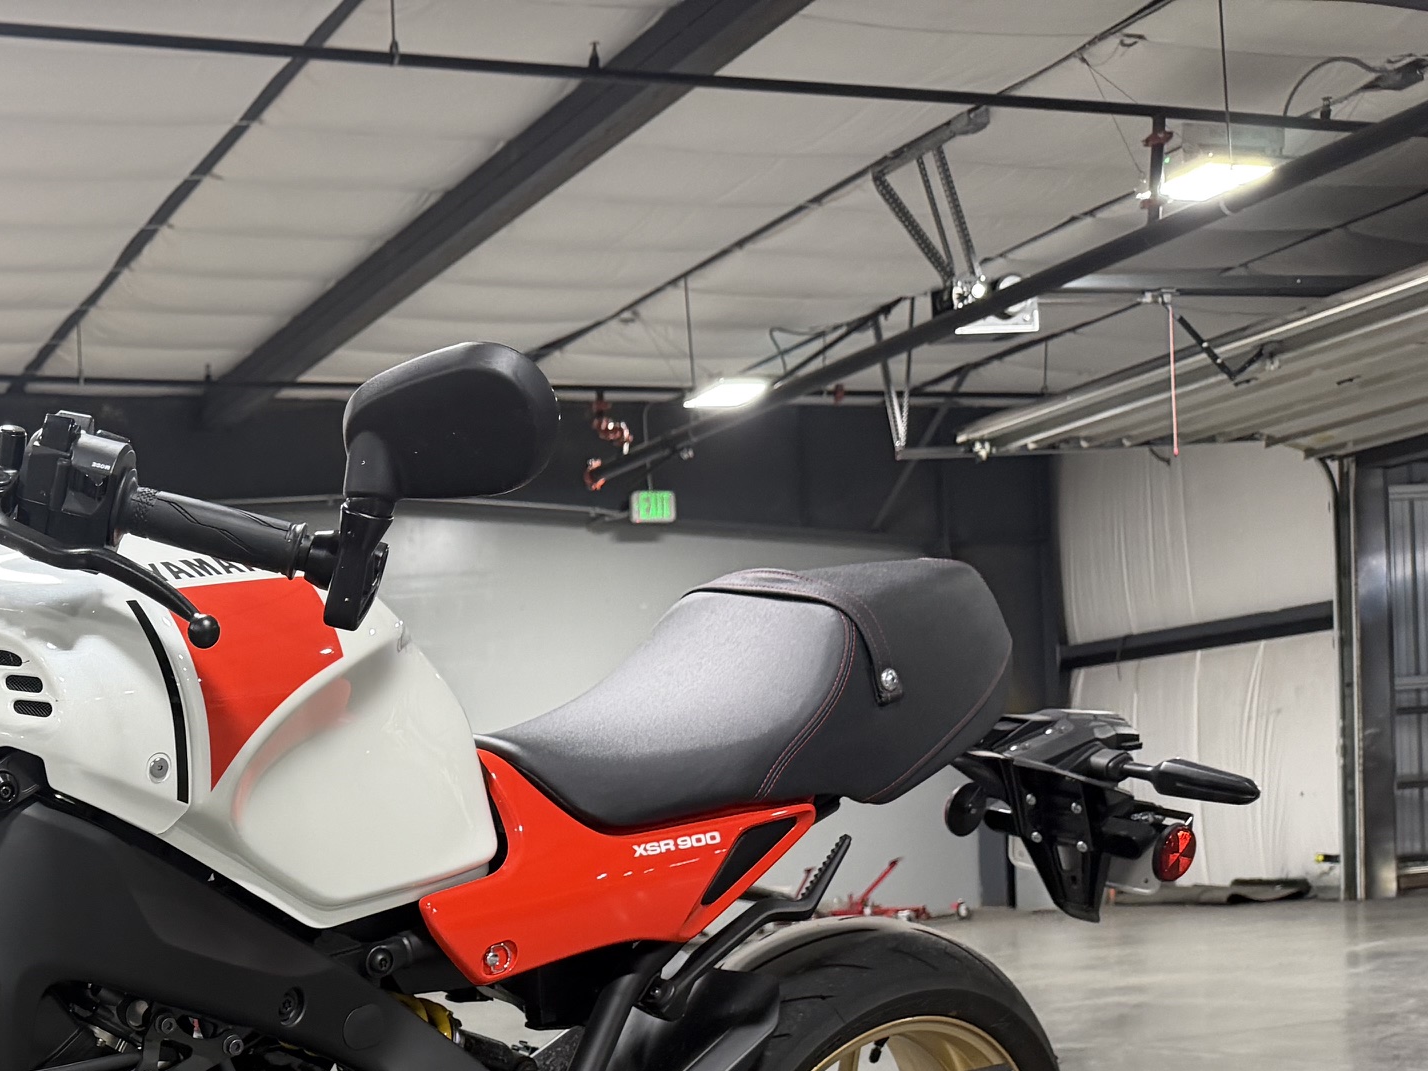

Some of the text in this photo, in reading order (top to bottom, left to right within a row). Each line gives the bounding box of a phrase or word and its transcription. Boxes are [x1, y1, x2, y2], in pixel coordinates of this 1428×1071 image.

[639, 491, 671, 518] EXIT
[147, 557, 256, 582] YAMA
[632, 831, 721, 857] XSR 900
